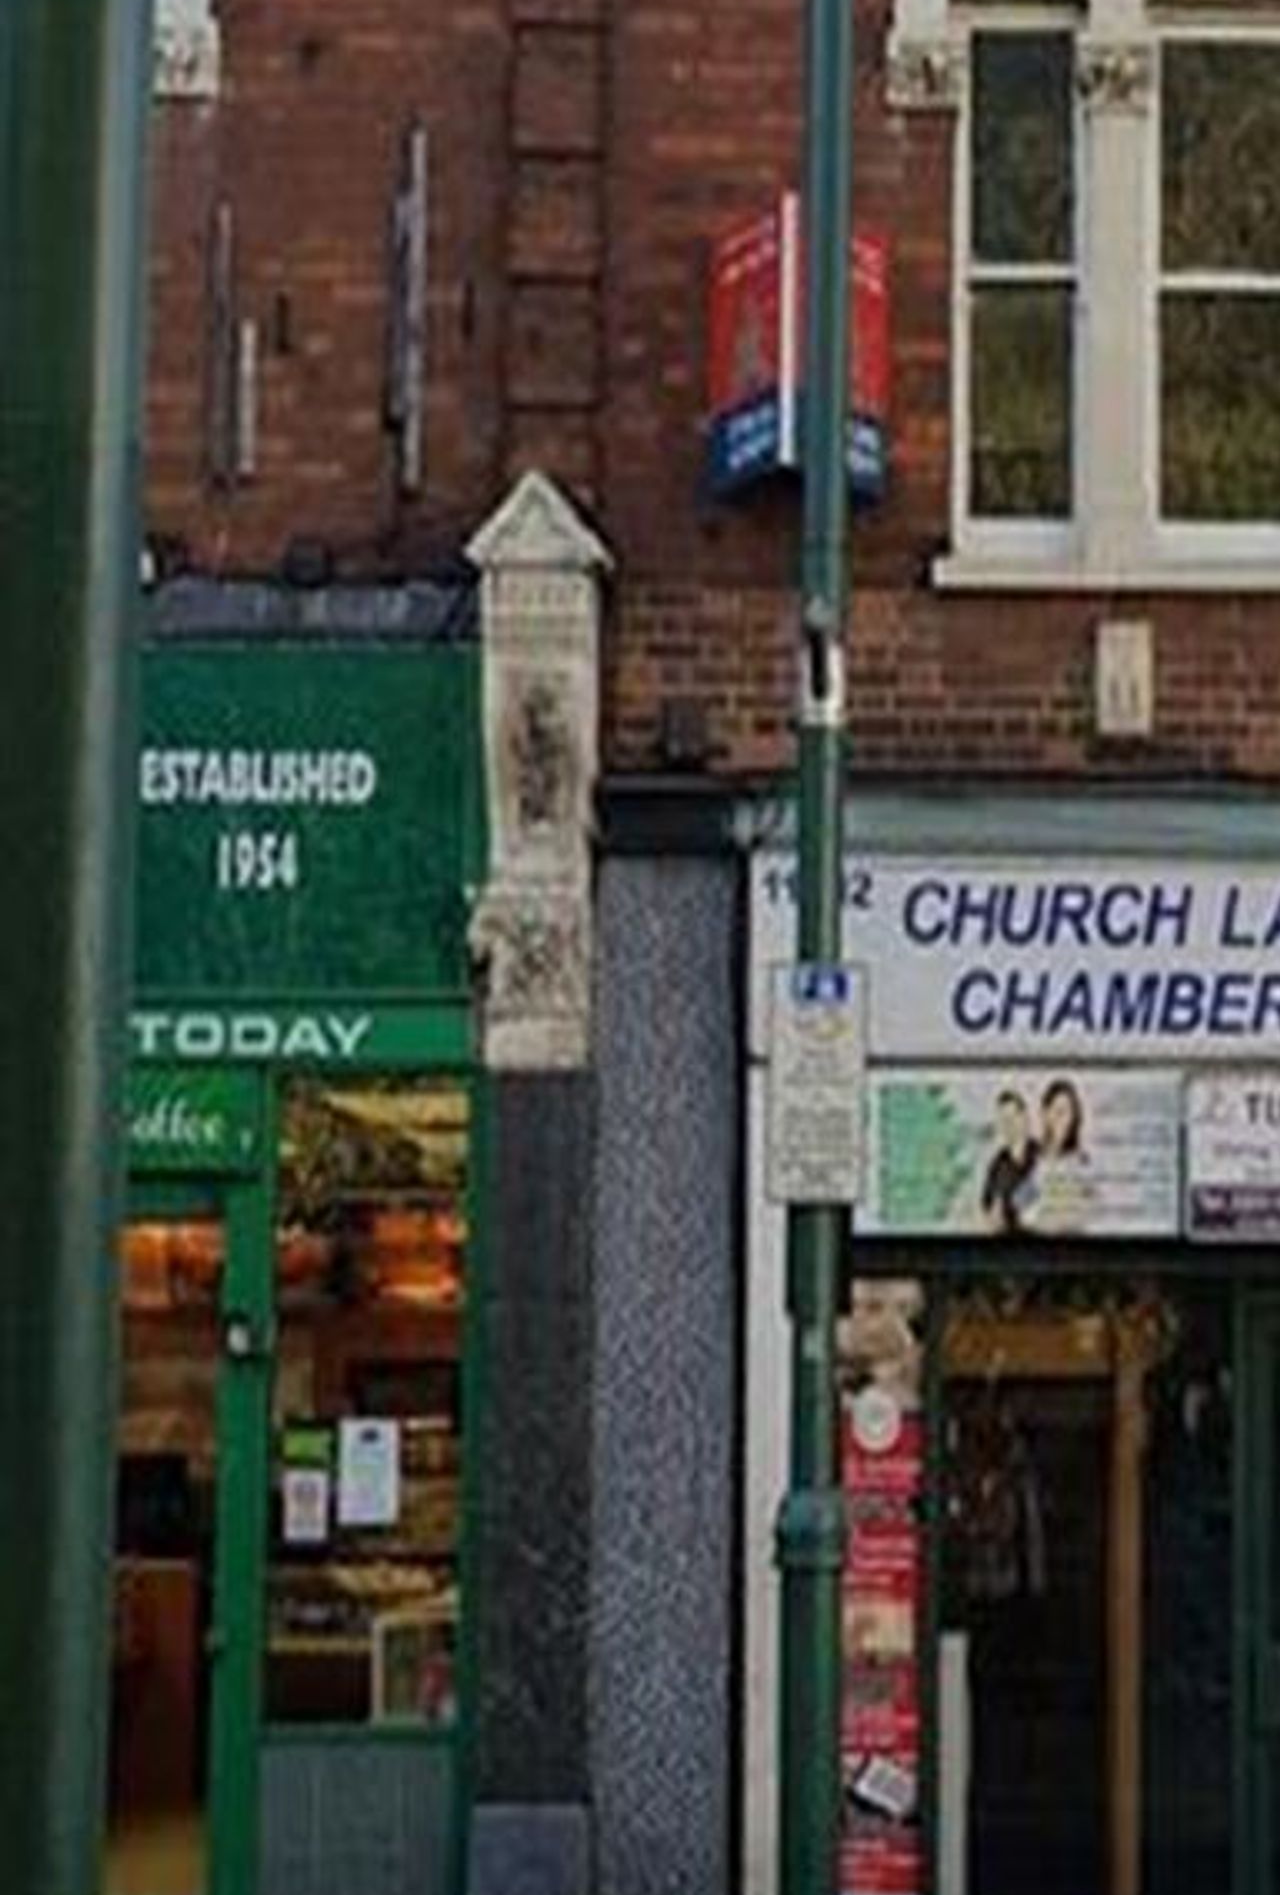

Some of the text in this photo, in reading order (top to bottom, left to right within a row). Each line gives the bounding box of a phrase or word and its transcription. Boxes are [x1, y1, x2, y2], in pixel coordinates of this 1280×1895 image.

[140, 748, 377, 804] ESTABLISHED
[217, 834, 298, 890] 1954
[903, 880, 1193, 946] CHURCH
[127, 1011, 373, 1057] TODAY
